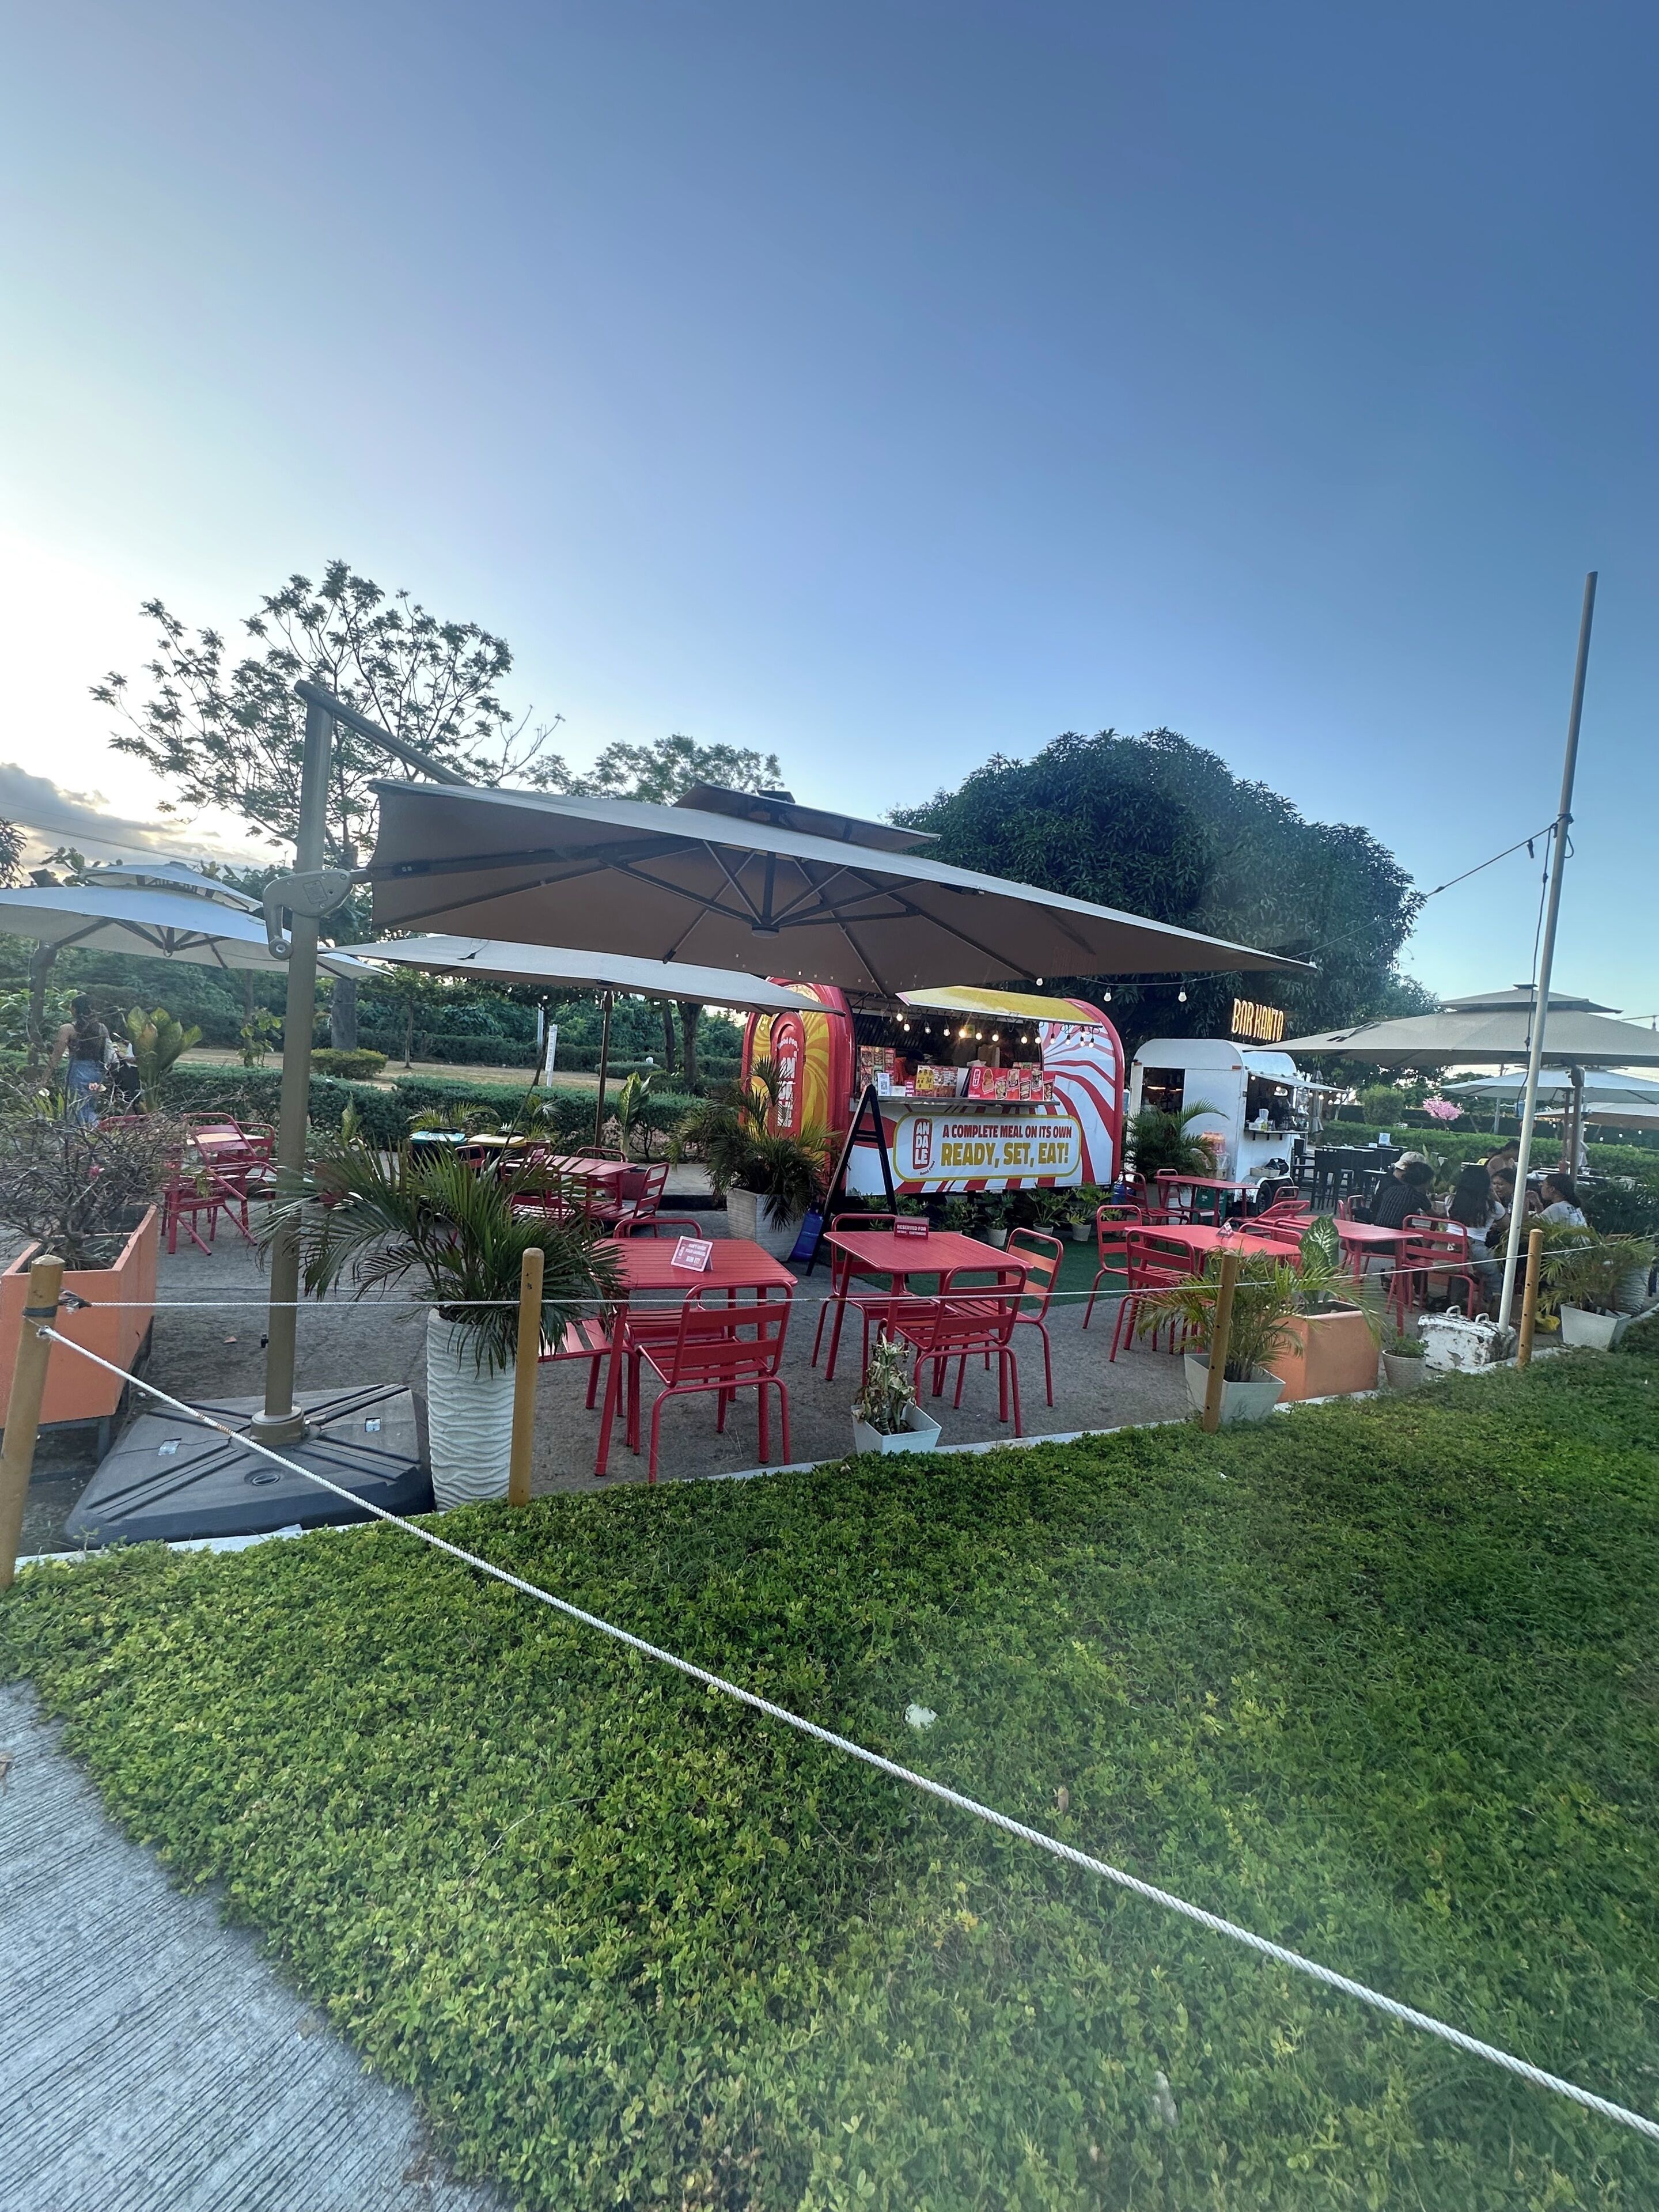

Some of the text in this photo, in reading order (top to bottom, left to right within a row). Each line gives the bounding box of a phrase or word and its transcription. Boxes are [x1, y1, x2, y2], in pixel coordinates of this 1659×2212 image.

[1232, 998, 1284, 1041] BAR KANTO
[916, 1122, 930, 1135] AN
[942, 1124, 1072, 1138] A COMPLETE MEAL ON ITS OWN
[915, 1135, 929, 1148] DA
[915, 1149, 928, 1164] LE
[941, 1142, 1069, 1168] READY, SET, EAT!
